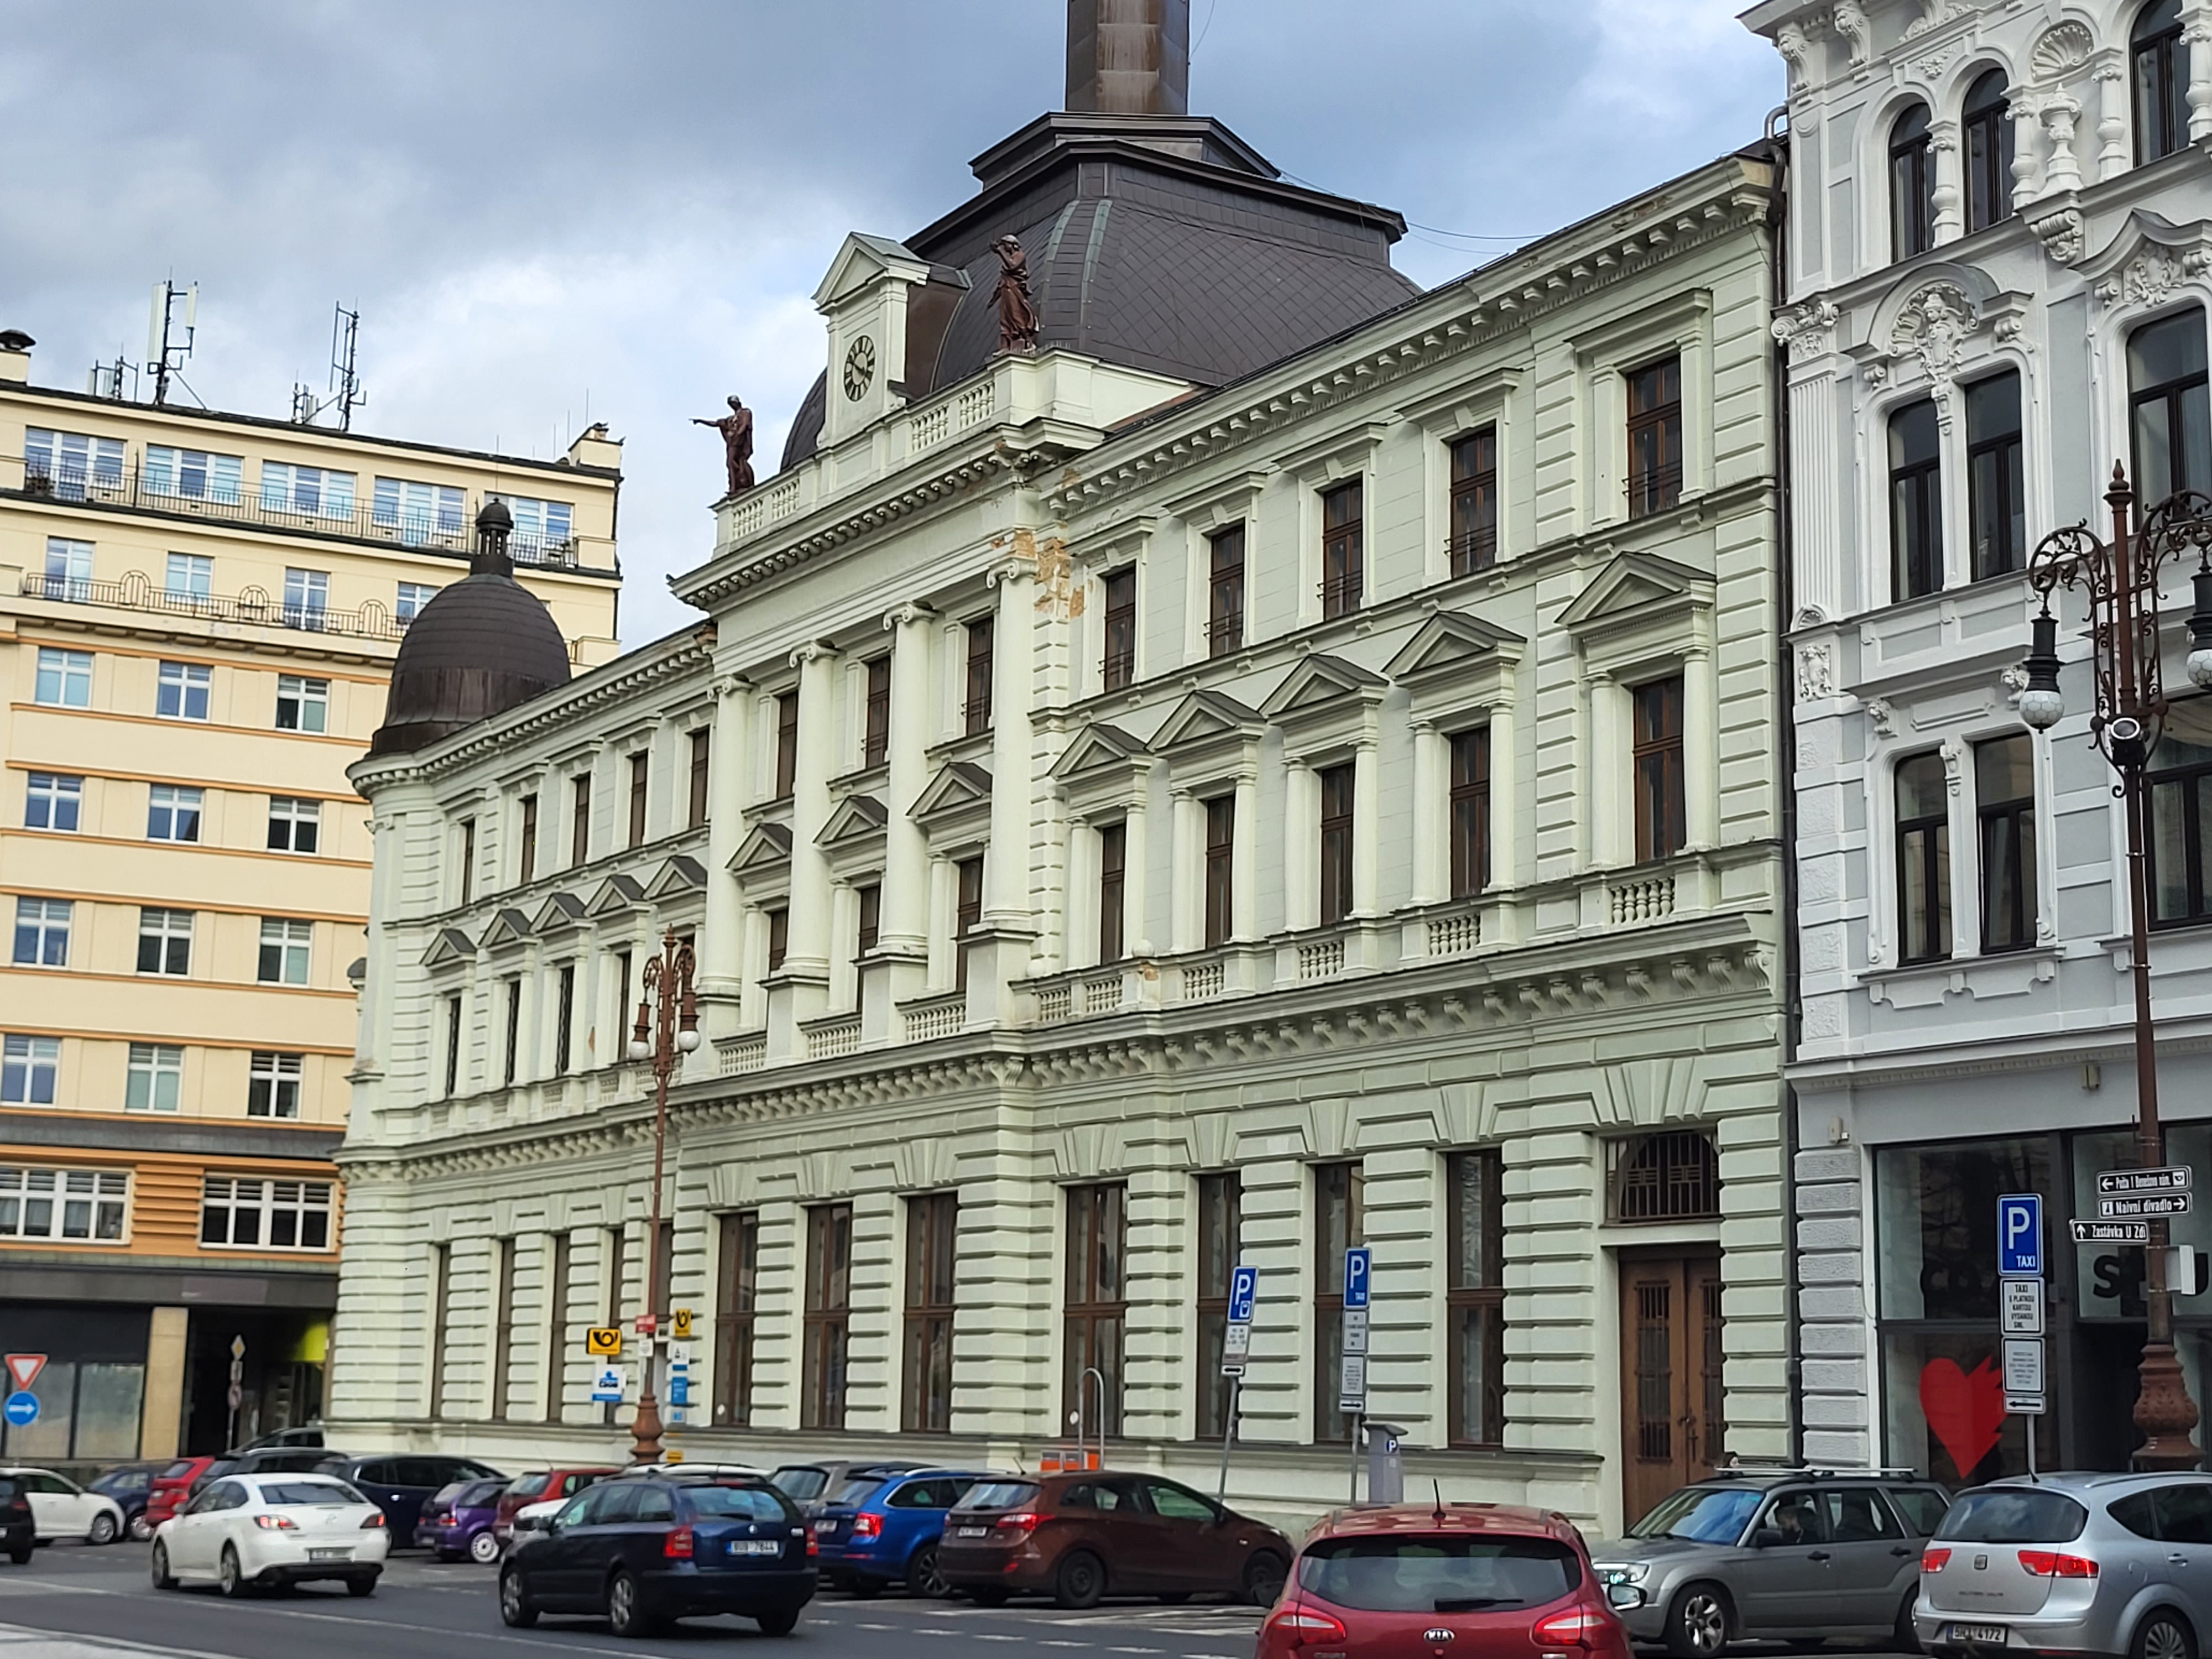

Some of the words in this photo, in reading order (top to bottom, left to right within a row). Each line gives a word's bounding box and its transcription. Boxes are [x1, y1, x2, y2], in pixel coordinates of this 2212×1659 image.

[2143, 1199, 2172, 1212] divadlo
[2008, 1207, 2030, 1249] P
[2092, 1224, 2123, 1238] Zastávka
[2126, 1225, 2131, 1238] U
[2016, 1255, 2036, 1267] TAXI
[1350, 1255, 1365, 1289] P
[1235, 1274, 1251, 1306] P
[2015, 1284, 2028, 1292] TAXI
[1389, 1440, 1397, 1453] P
[1428, 1630, 1449, 1640] KIA
